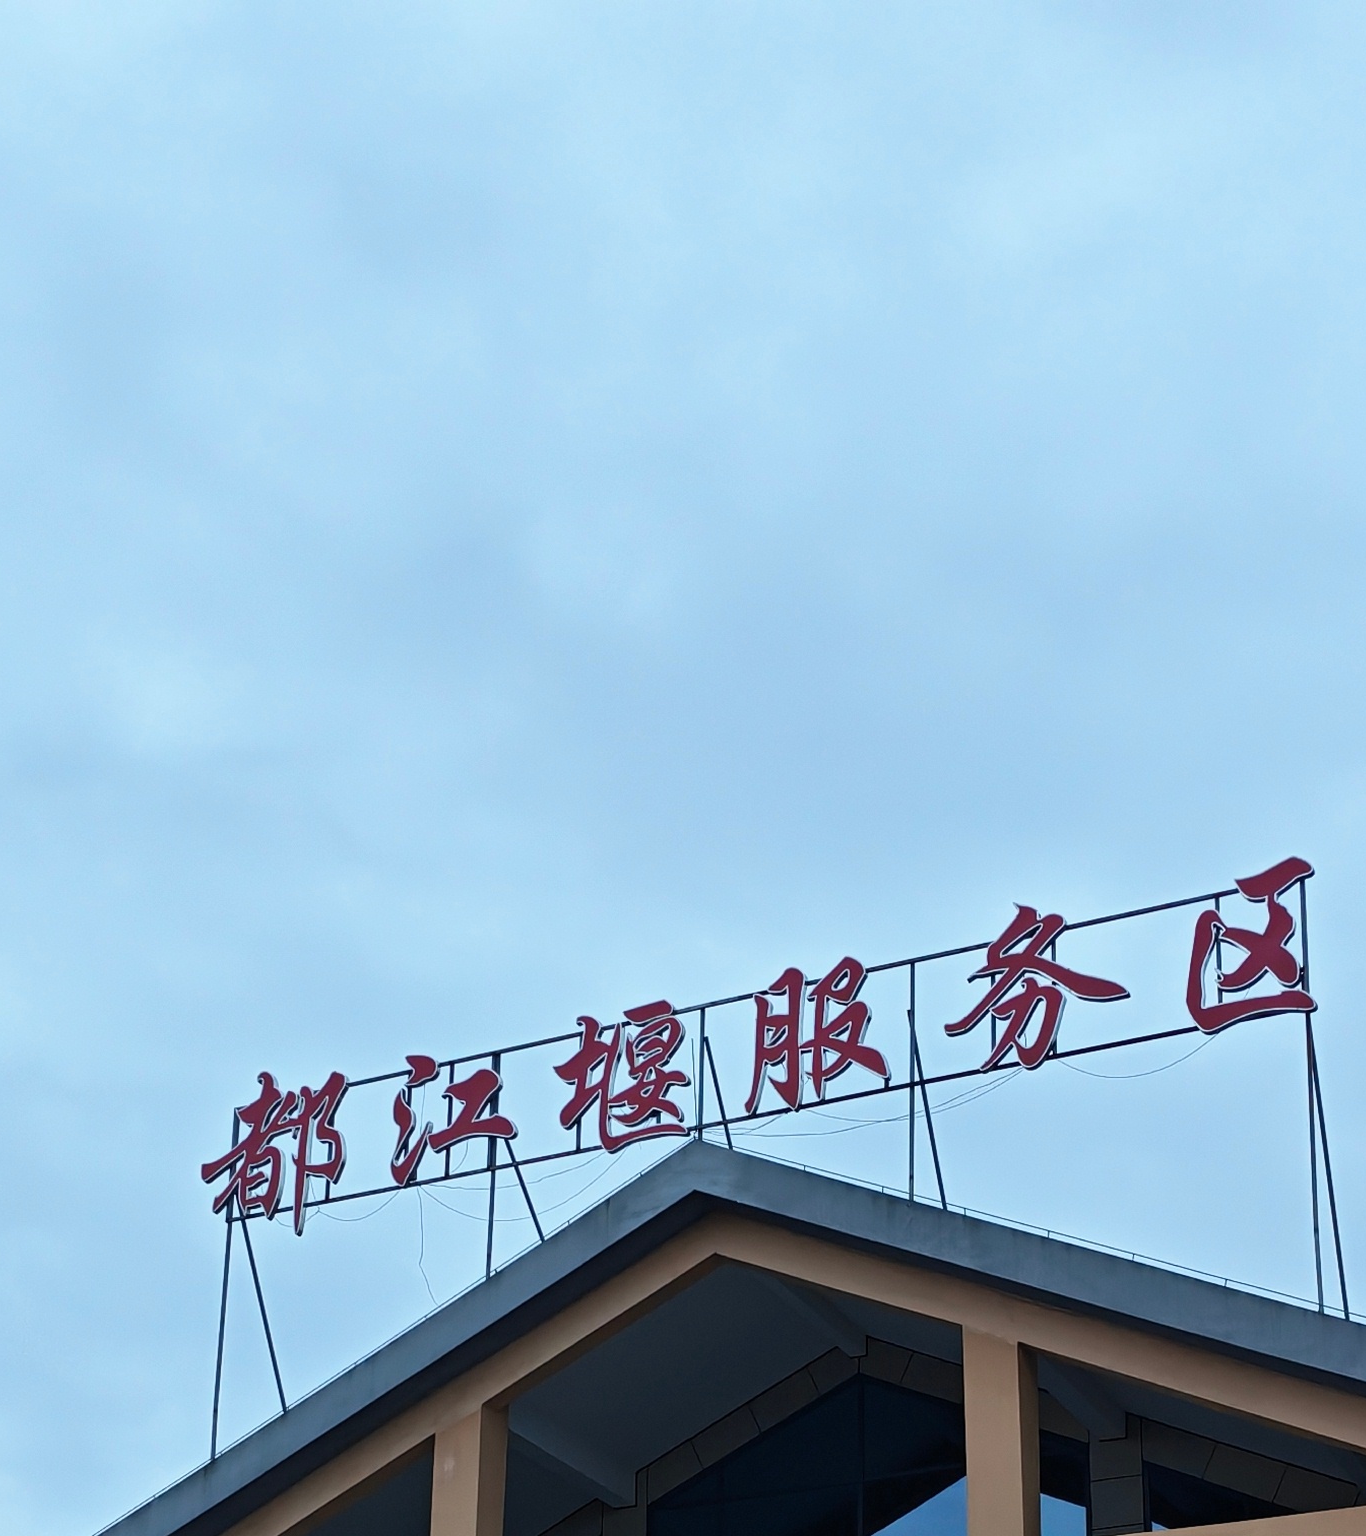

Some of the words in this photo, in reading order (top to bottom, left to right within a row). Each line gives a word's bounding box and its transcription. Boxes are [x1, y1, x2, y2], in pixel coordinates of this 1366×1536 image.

[201, 857, 1316, 1235] 都江堰服务区
